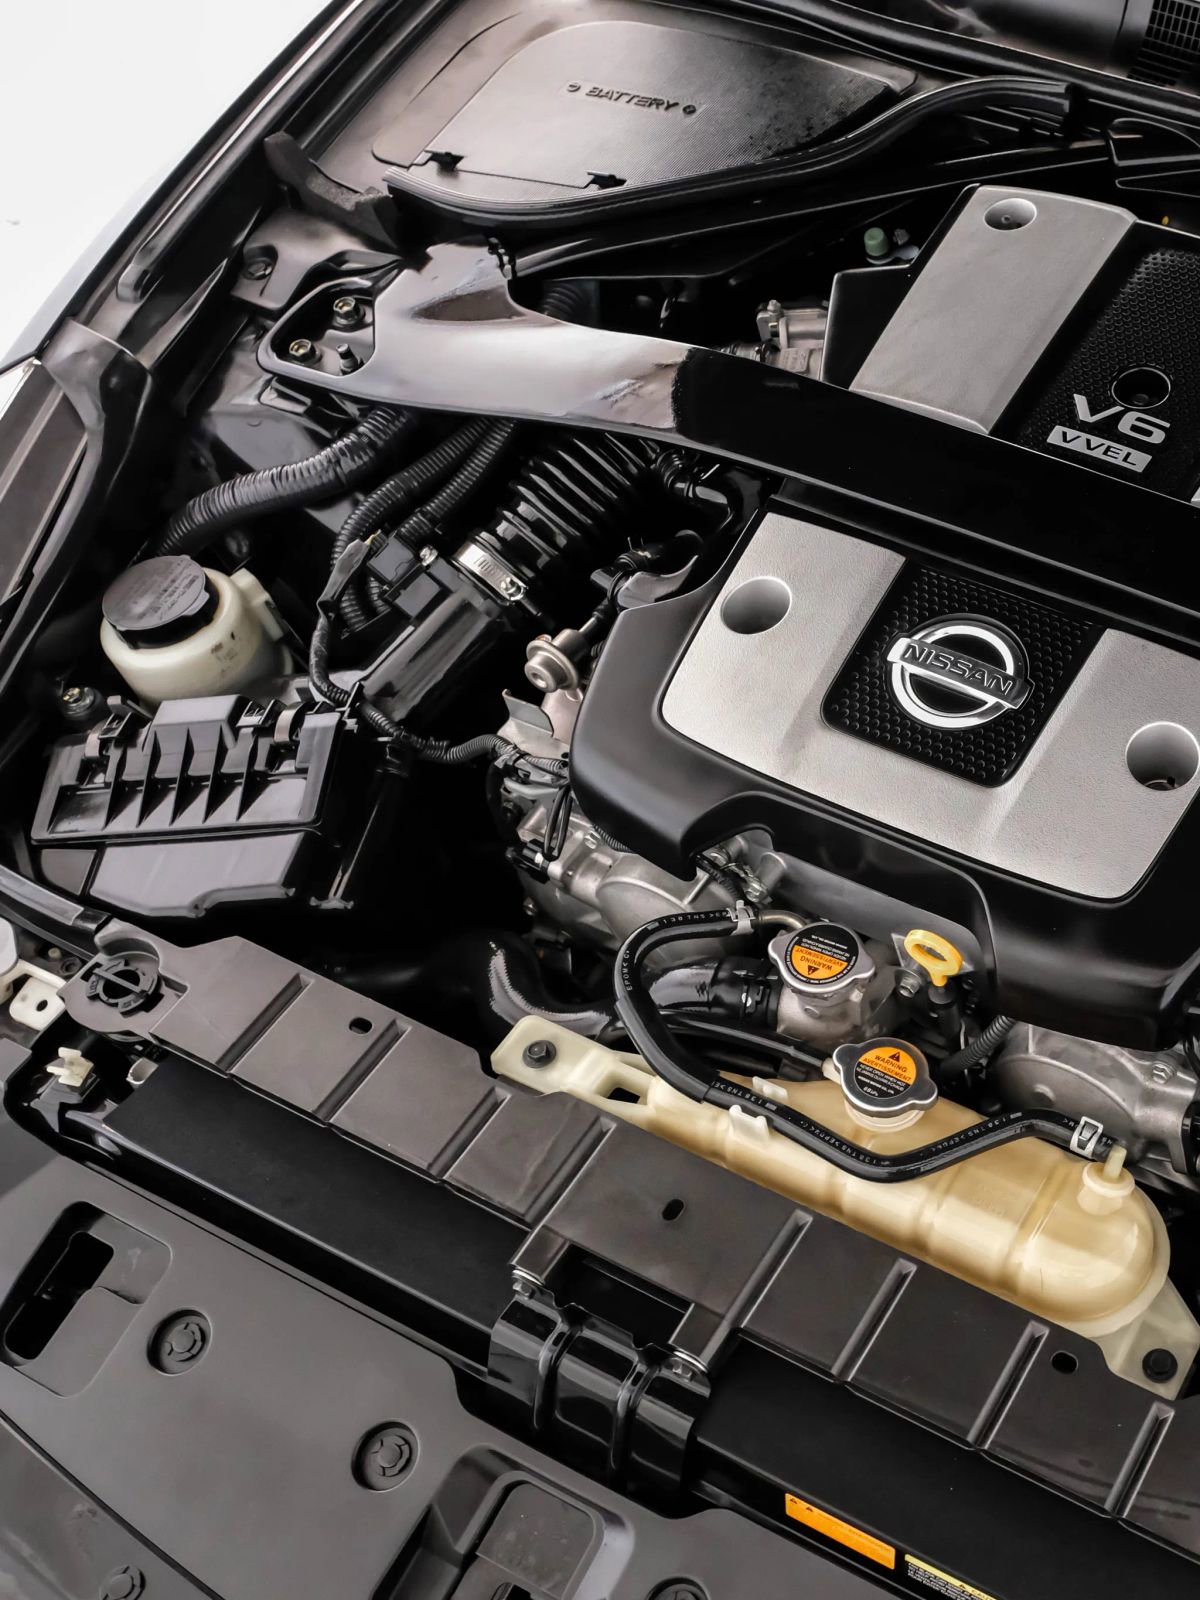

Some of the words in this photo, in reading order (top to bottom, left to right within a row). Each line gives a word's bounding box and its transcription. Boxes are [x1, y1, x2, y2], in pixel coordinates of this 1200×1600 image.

[585, 86, 679, 111] BATTERY
[1073, 393, 1171, 444] V6
[1062, 430, 1138, 466] VVEL
[903, 643, 1014, 696] NISSAN
[800, 956, 833, 971] WARNING
[863, 1058, 912, 1082] AVERTISSEMENT
[875, 1055, 908, 1073] WARNING
